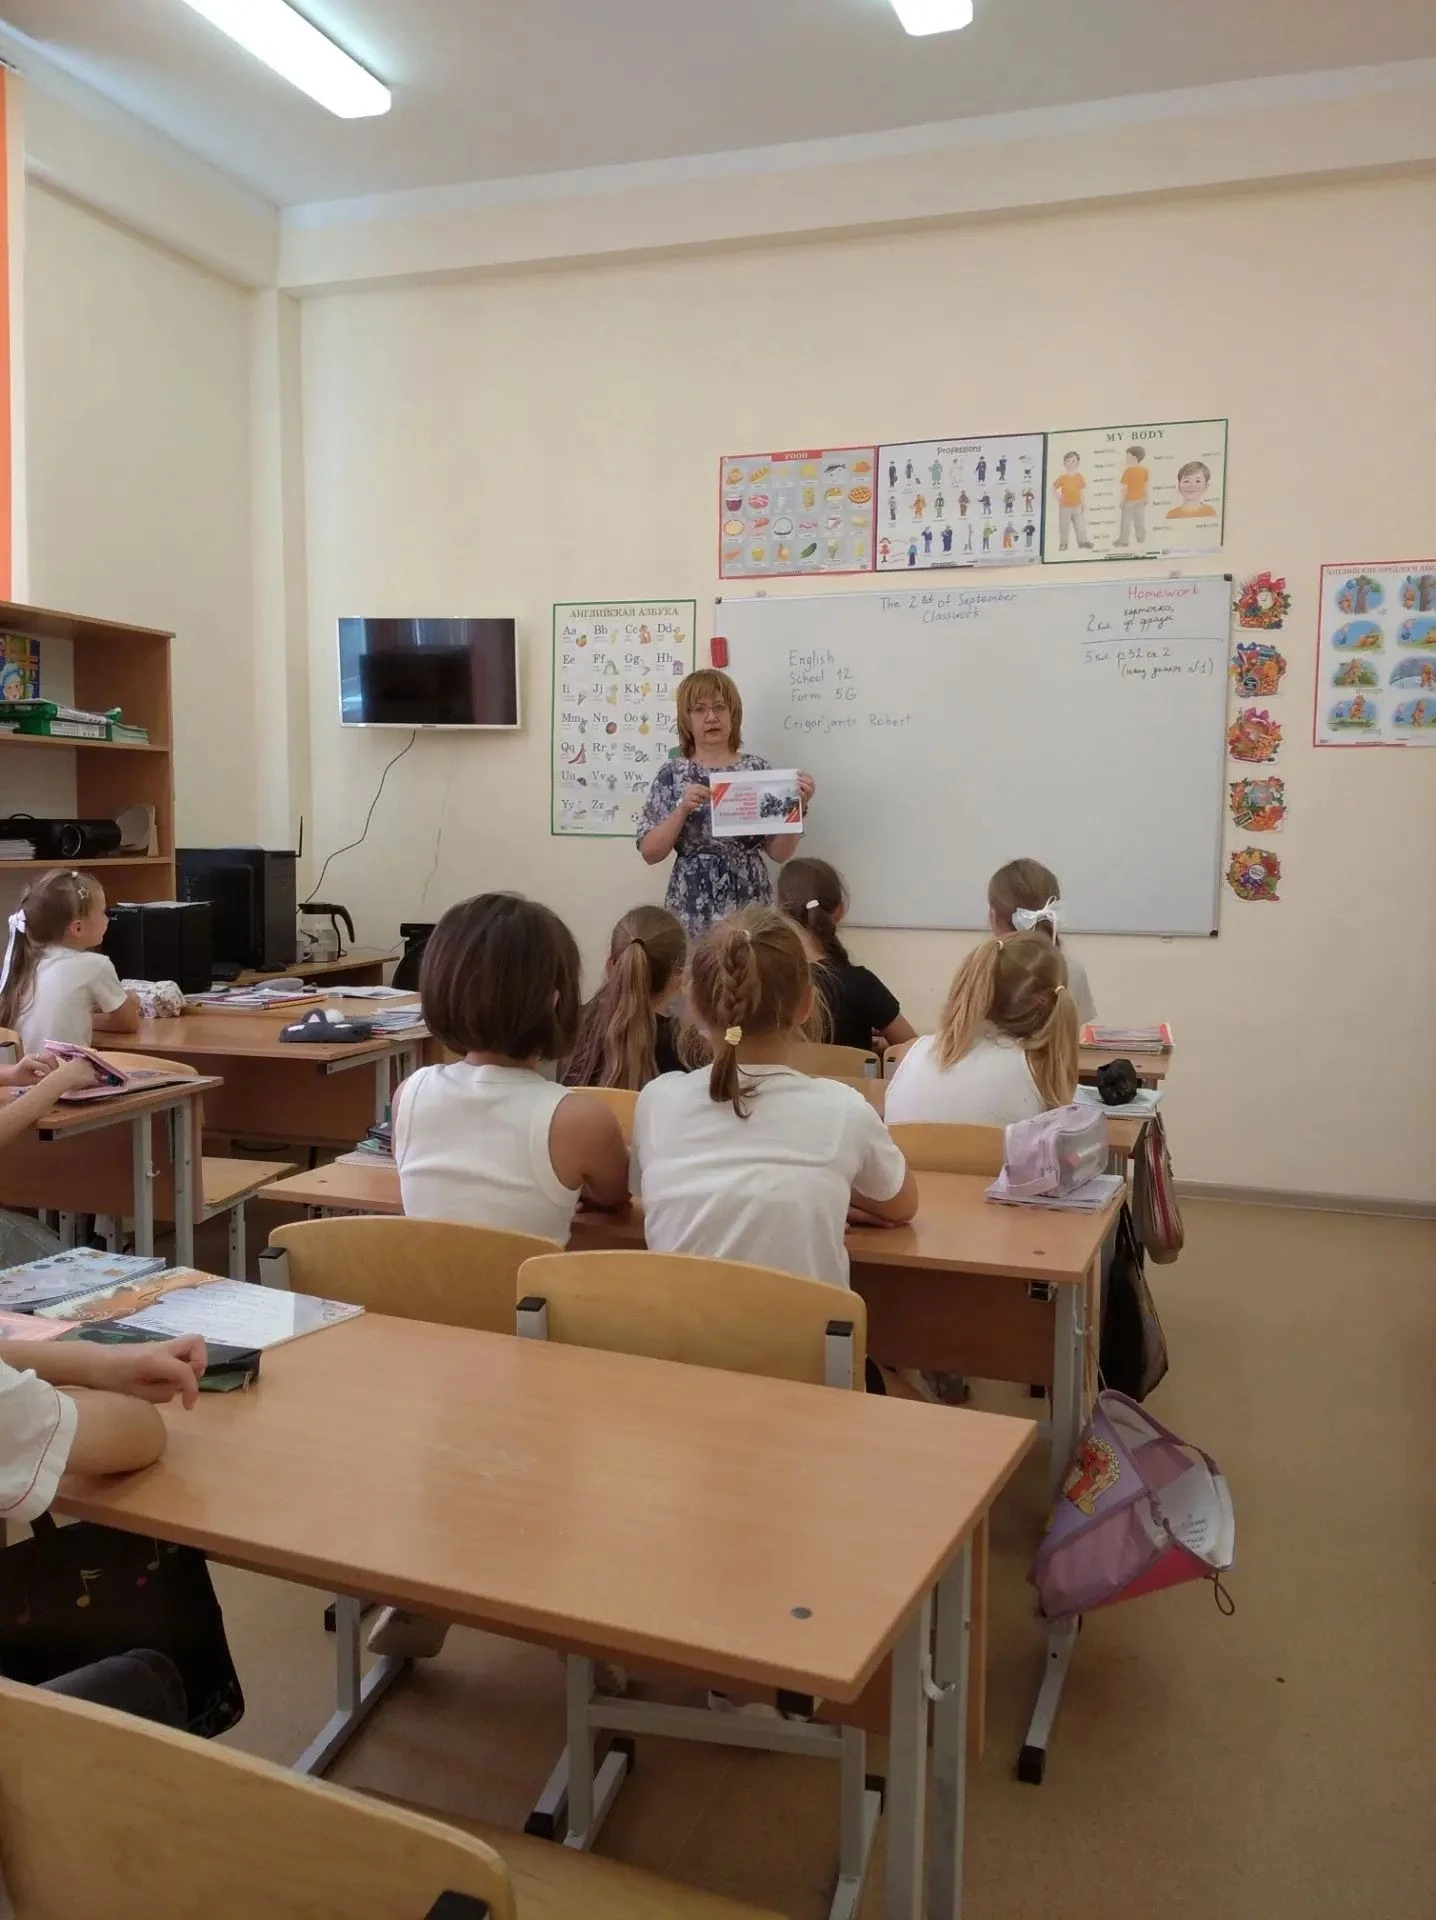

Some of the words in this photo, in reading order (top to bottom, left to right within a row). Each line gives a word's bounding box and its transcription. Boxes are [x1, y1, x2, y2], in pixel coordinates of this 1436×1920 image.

[1106, 433, 1124, 442] MY
[1131, 430, 1165, 441] BODY
[785, 452, 809, 461] FOOD
[937, 445, 982, 456] Professions
[1128, 584, 1200, 600] Homework
[880, 597, 901, 610] The
[938, 592, 950, 608] of
[958, 590, 1016, 611] September
[570, 608, 635, 618] АНГЛИЙСКАЯ
[639, 607, 680, 617] АЗБУКА
[922, 607, 981, 623] Classwork
[657, 623, 672, 633] Dd
[624, 653, 640, 665] Gg
[656, 653, 673, 663] Hh
[789, 649, 834, 672] English
[790, 669, 824, 685] School
[837, 667, 853, 680] 12
[624, 683, 640, 694] Kk
[792, 688, 820, 702] Form
[869, 713, 911, 727] Robert
